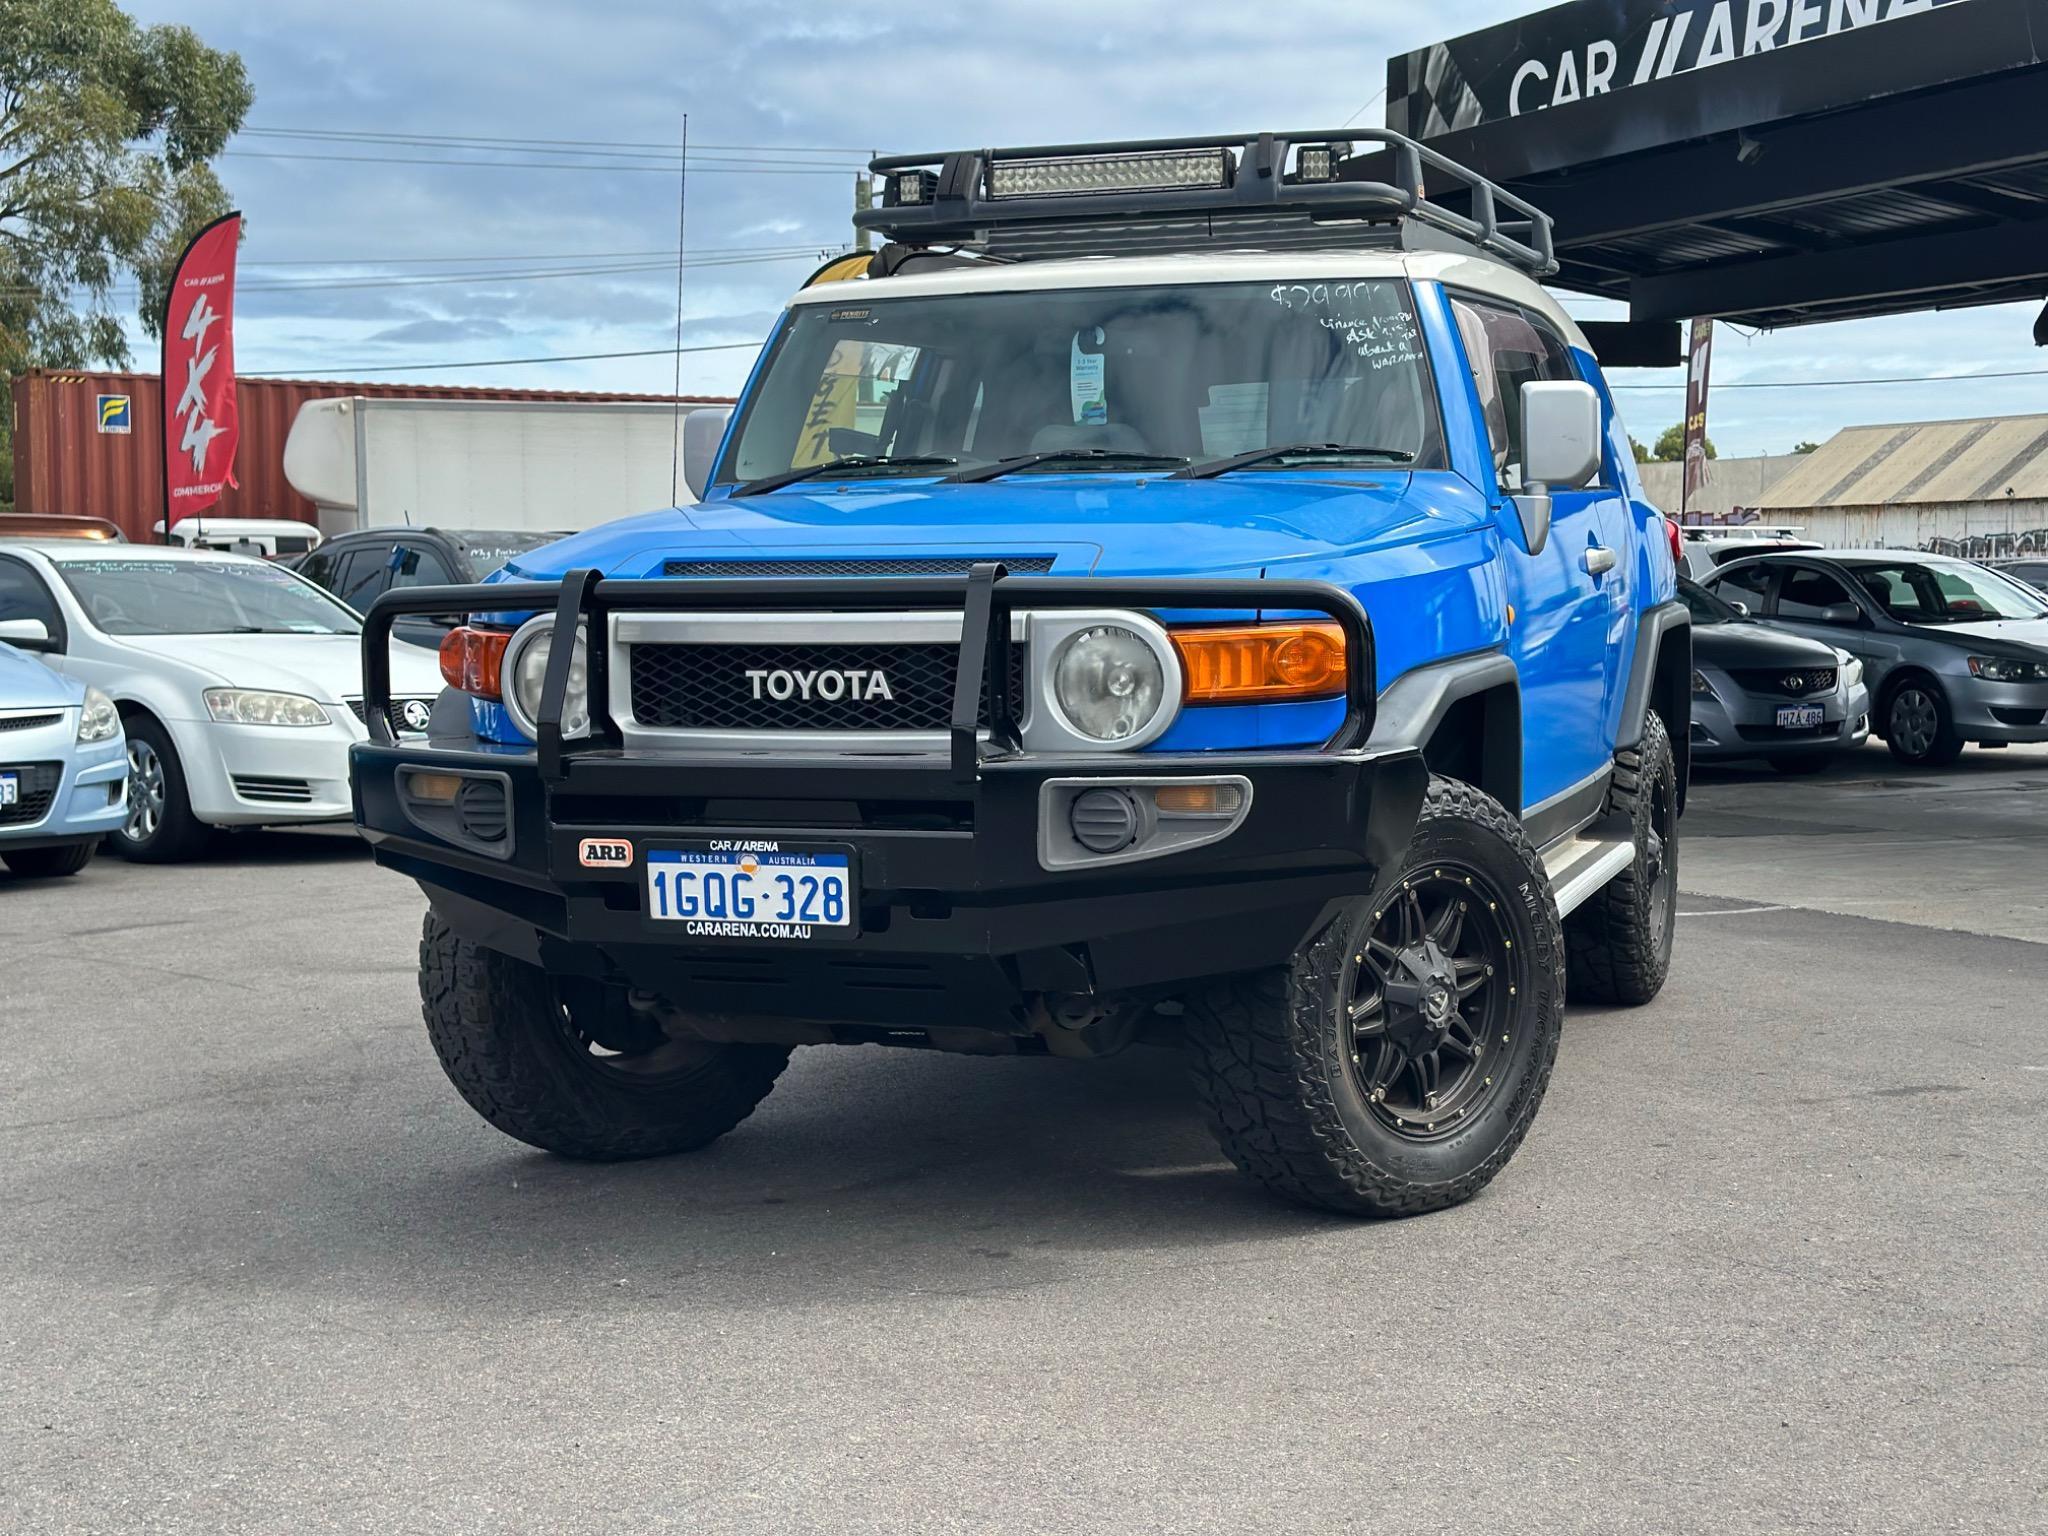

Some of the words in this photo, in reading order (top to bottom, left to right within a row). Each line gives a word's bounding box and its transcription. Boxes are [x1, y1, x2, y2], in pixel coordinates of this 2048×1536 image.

[1509, 39, 1617, 117] CAR
[1346, 328, 1378, 344] Ask
[745, 669, 893, 701] TOYOTA
[586, 844, 627, 861] ARB
[709, 840, 732, 851] CAR
[741, 841, 779, 852] ARENA
[681, 854, 728, 863] WESTERN
[769, 856, 816, 866] AUSTRALIA
[686, 921, 811, 939] CARARENA.COM.AU
[1518, 882, 1550, 970] MICKEY
